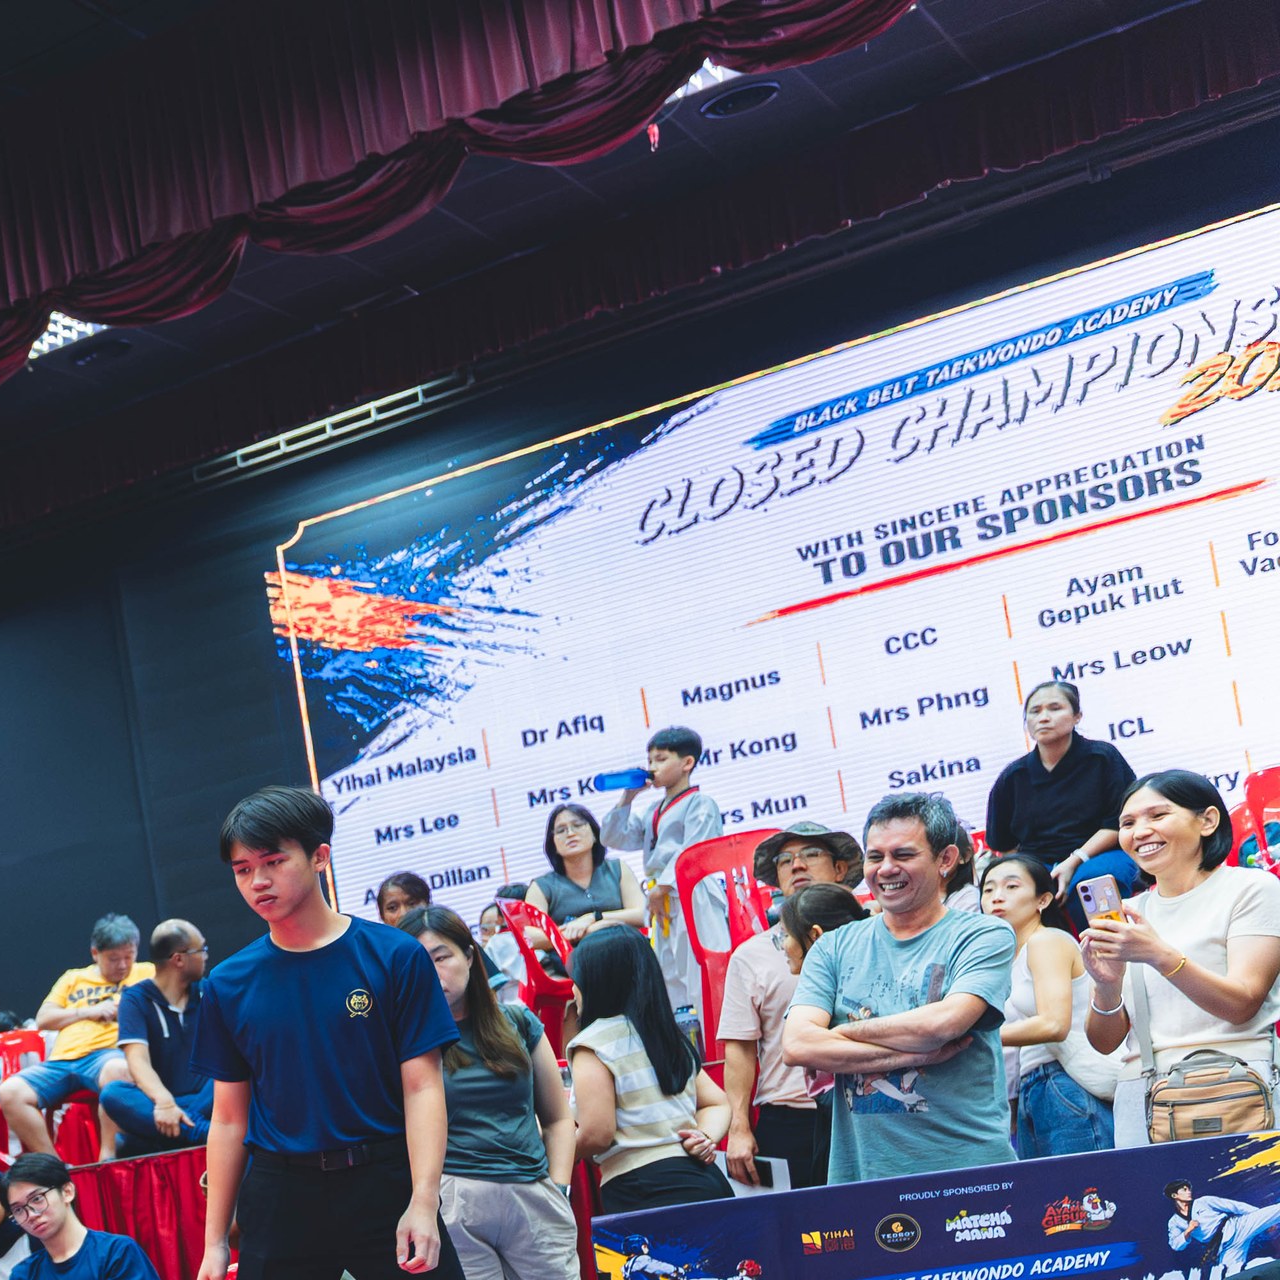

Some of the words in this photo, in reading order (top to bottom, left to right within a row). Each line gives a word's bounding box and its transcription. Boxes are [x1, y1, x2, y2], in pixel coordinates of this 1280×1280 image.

[793, 395, 858, 433] BLACK
[865, 375, 924, 409] BELT
[925, 327, 1063, 388] TAEKWONDO
[1068, 286, 1180, 339] ACADEMY
[1158, 340, 1280, 428] 20
[635, 427, 865, 545] CLOSED
[796, 531, 863, 561] WITH
[874, 496, 986, 539] SINCERE
[999, 434, 1206, 506] APPRECIATION
[813, 552, 866, 584] TO
[880, 526, 962, 567] OUR
[976, 459, 1203, 541] SPONSORS
[1066, 565, 1144, 597] Ayam
[1239, 556, 1280, 576] Va
[1038, 594, 1125, 628] Gepuk
[1133, 578, 1184, 605] Hut
[884, 627, 938, 655] CCC
[1051, 659, 1105, 682] Mrs
[1114, 638, 1192, 669] Leow
[680, 670, 781, 708] Magnus
[859, 704, 909, 730] Mrs
[916, 686, 989, 717] Phng
[521, 726, 549, 748] Dr
[555, 714, 605, 739] Afiq
[1108, 717, 1154, 741] ICL
[730, 731, 798, 761] Kong
[387, 745, 477, 782] Malaysia
[888, 756, 982, 789] Sakina
[527, 785, 571, 808] Mrs
[720, 809, 744, 825] rs
[751, 793, 807, 819] Mun
[374, 821, 415, 845] Mrs
[420, 812, 459, 836] Lee
[429, 865, 491, 890] Dillan
[899, 1189, 941, 1202] PROUDLY
[942, 1183, 1001, 1198] SPONSORED
[1001, 1181, 1014, 1191] BY
[946, 1209, 1013, 1232] MATCHA
[1041, 1209, 1089, 1228] GEPUK
[1044, 1204, 1081, 1217] AYAM
[823, 1229, 854, 1240] YIHAI
[1030, 1250, 1111, 1275] ACADEMY
